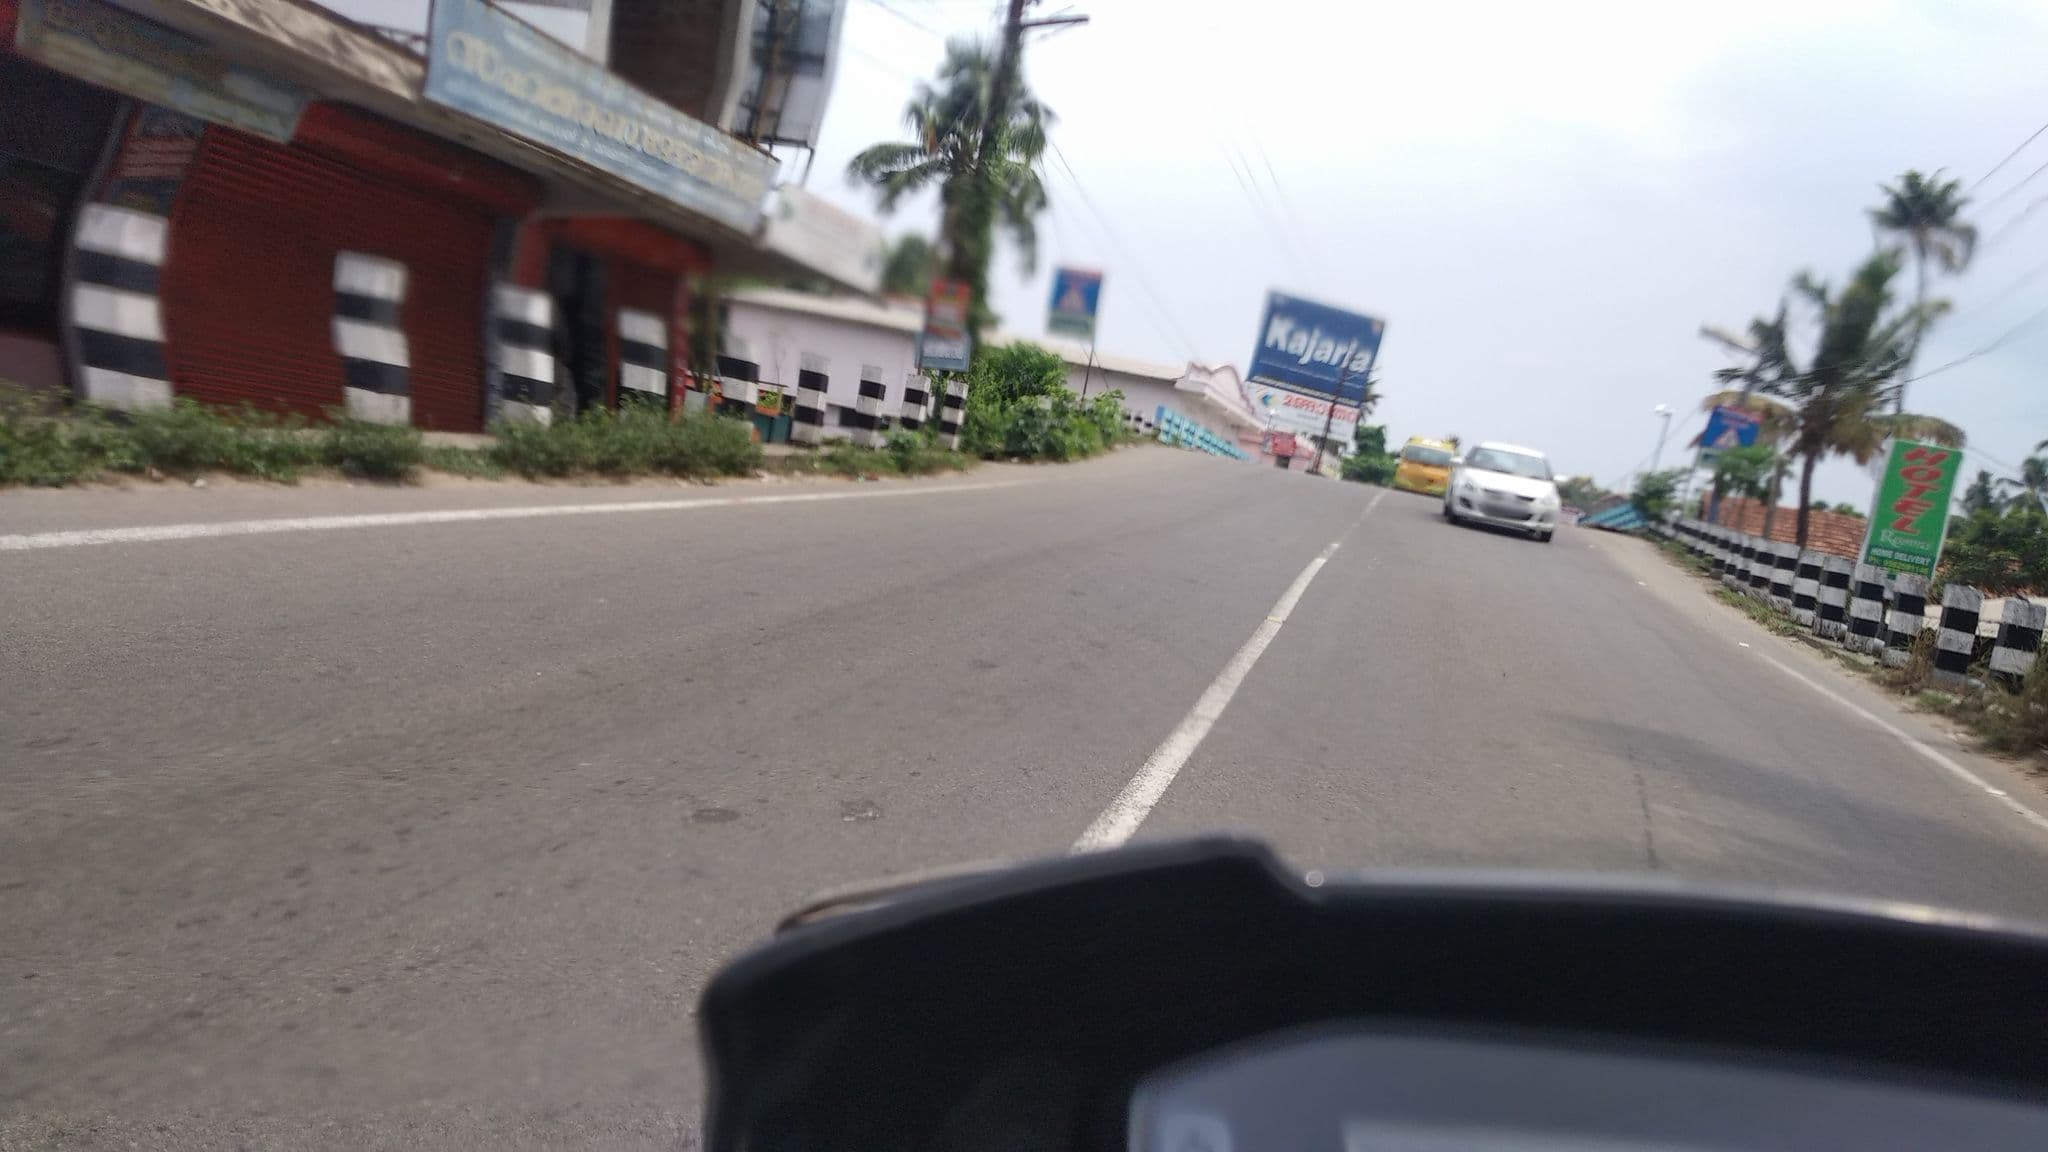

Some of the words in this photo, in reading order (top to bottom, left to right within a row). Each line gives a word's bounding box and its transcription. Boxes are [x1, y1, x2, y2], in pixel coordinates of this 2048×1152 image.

[1264, 316, 1373, 374] Kajaria
[1892, 447, 1949, 535] HOTEL
[1869, 547, 1894, 559] HOME
[1894, 552, 1931, 566] DELIVERY
